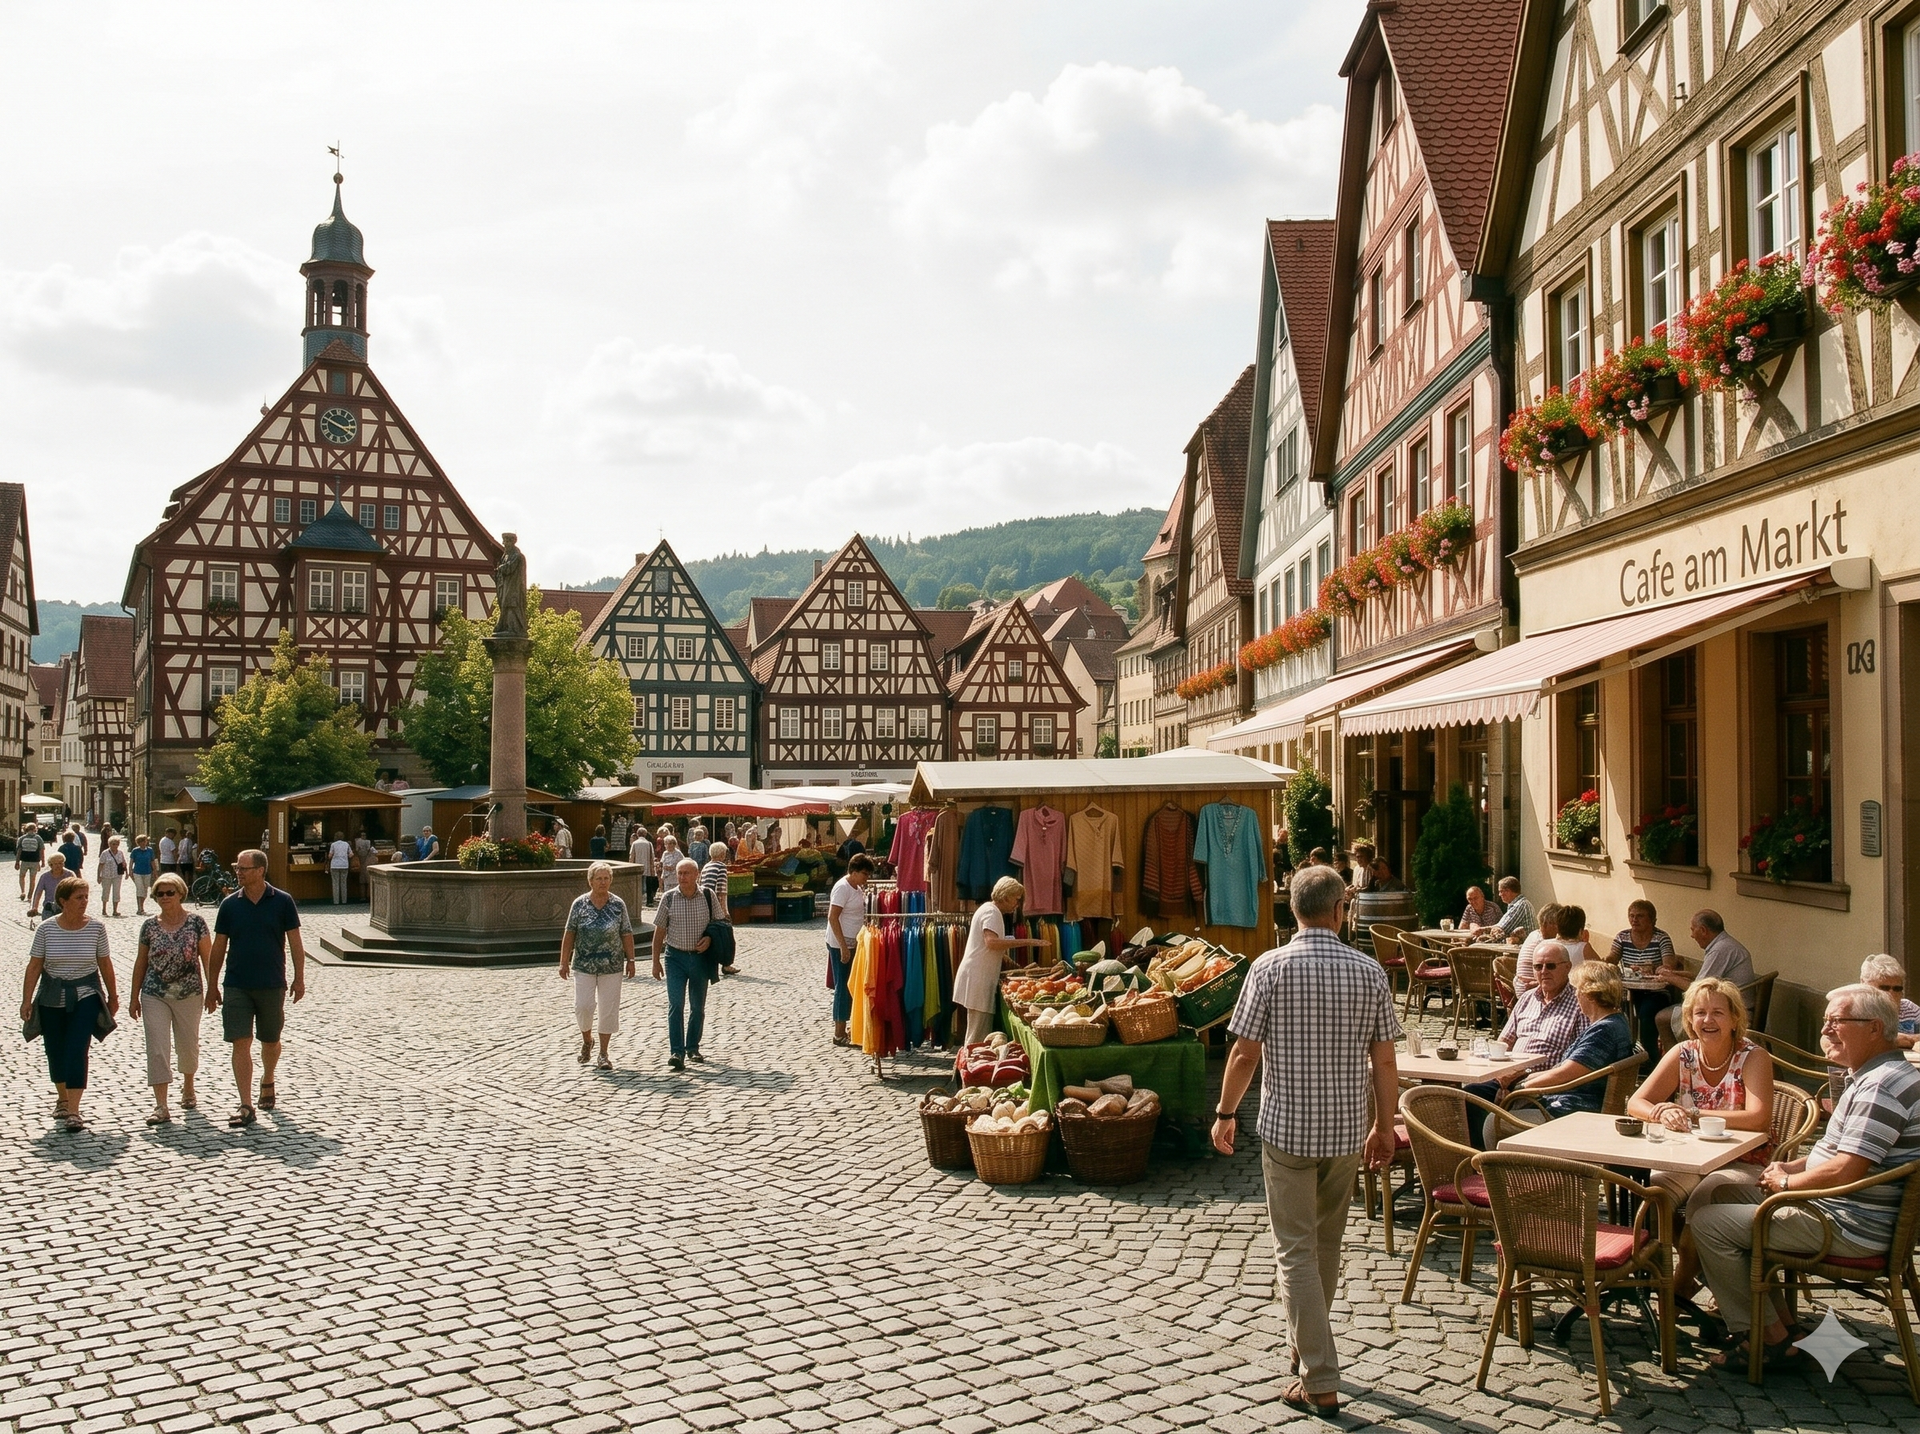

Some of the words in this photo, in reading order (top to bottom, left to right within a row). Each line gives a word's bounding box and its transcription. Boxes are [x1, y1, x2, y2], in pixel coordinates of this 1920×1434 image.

[1620, 548, 1674, 607] Cafe
[1684, 546, 1727, 592] am
[1741, 499, 1848, 578] Markt
